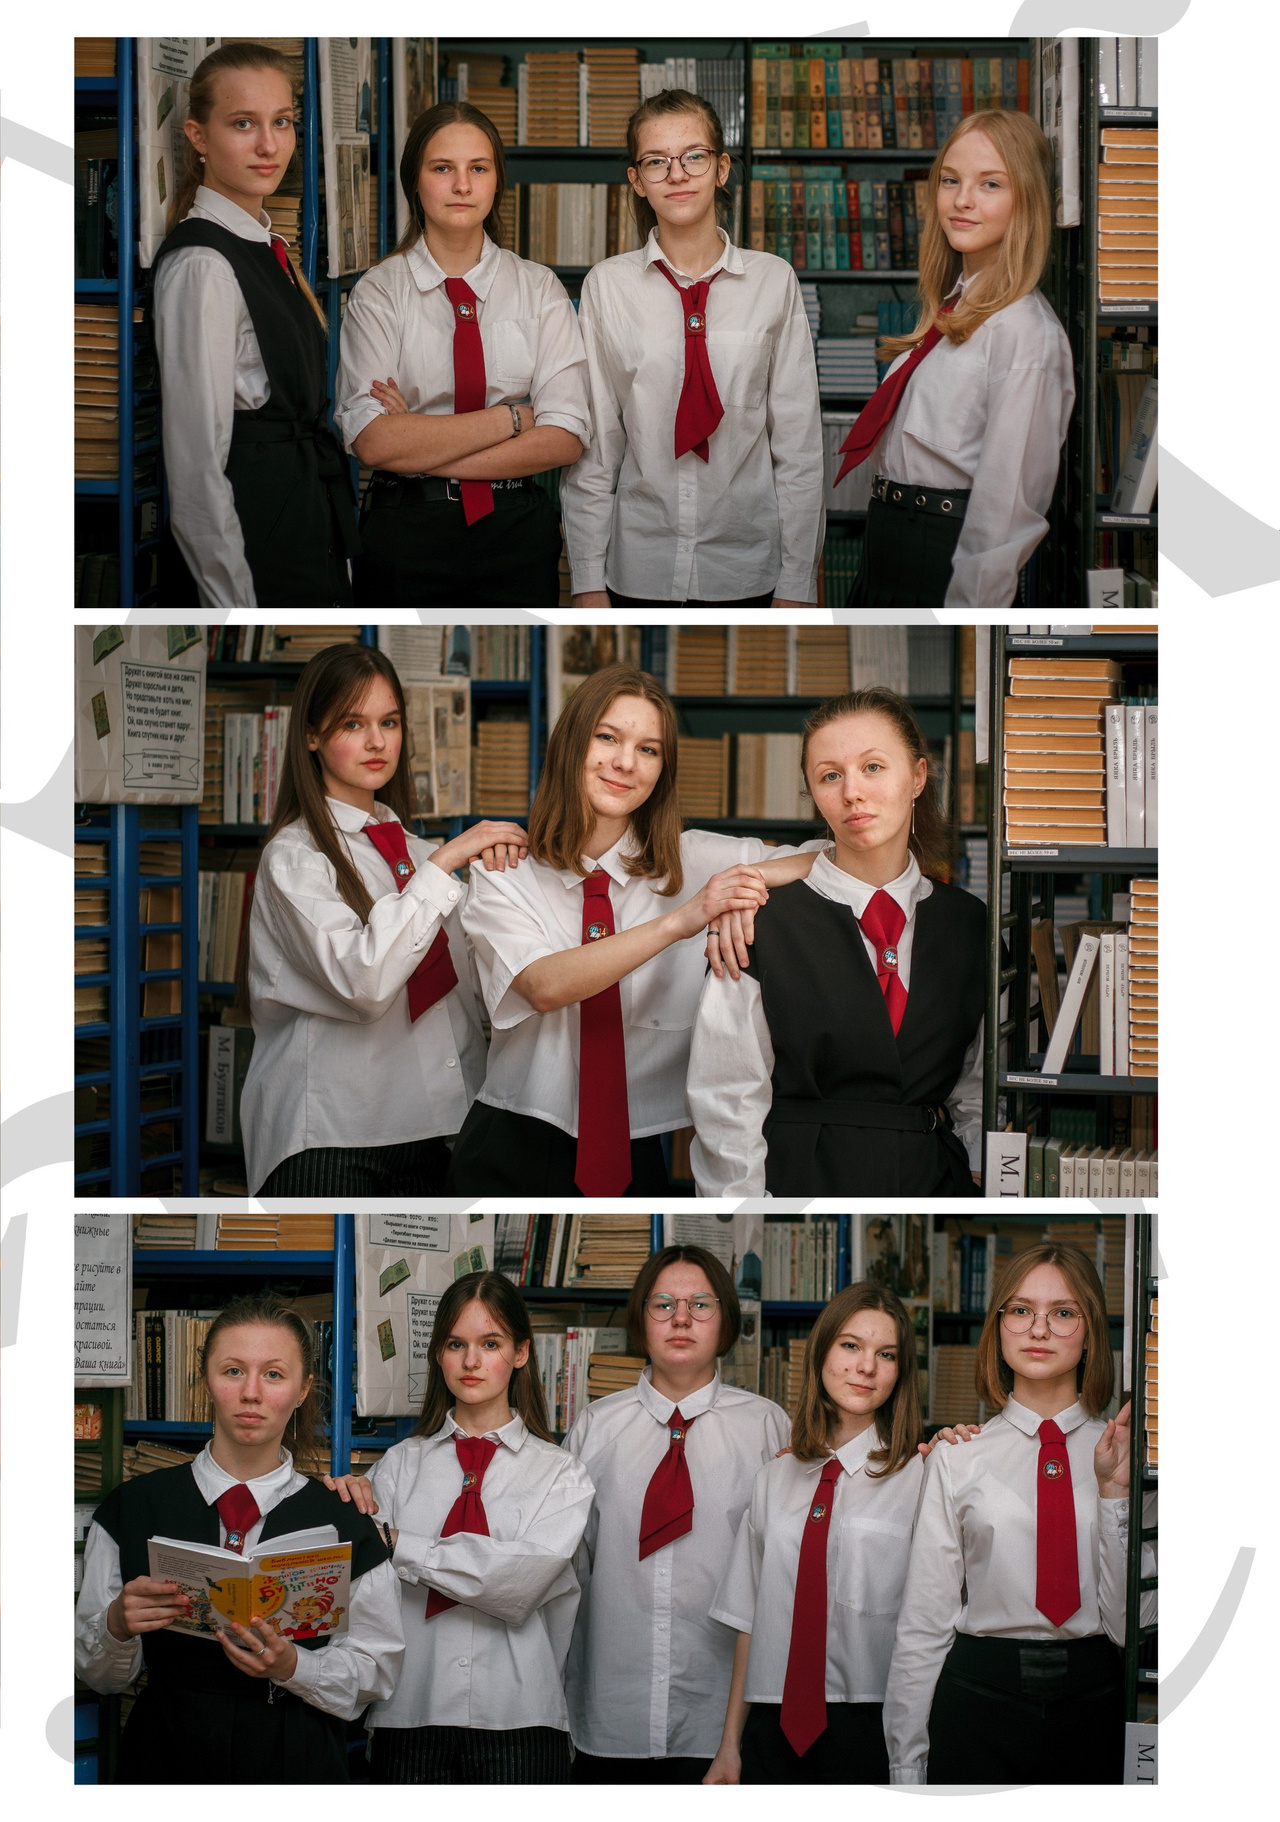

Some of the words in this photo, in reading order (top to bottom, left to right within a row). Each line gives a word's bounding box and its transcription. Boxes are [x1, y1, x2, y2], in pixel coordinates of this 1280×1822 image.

[124, 666, 141, 677] Дружат
[126, 678, 142, 690] Дружат
[128, 729, 141, 738] Книга
[214, 1064, 230, 1134] Булгаков
[1000, 1154, 1020, 1182] М.
[80, 1262, 114, 1277] рисуйте
[116, 1266, 121, 1274] в
[411, 1296, 428, 1306] Дружат
[411, 1307, 428, 1317] Дружат
[75, 1321, 116, 1332] остаться
[413, 1351, 427, 1360] Книга
[271, 1554, 320, 1564] Библиотека
[259, 1576, 339, 1598] Буратино
[1138, 1744, 1156, 1768] М.
